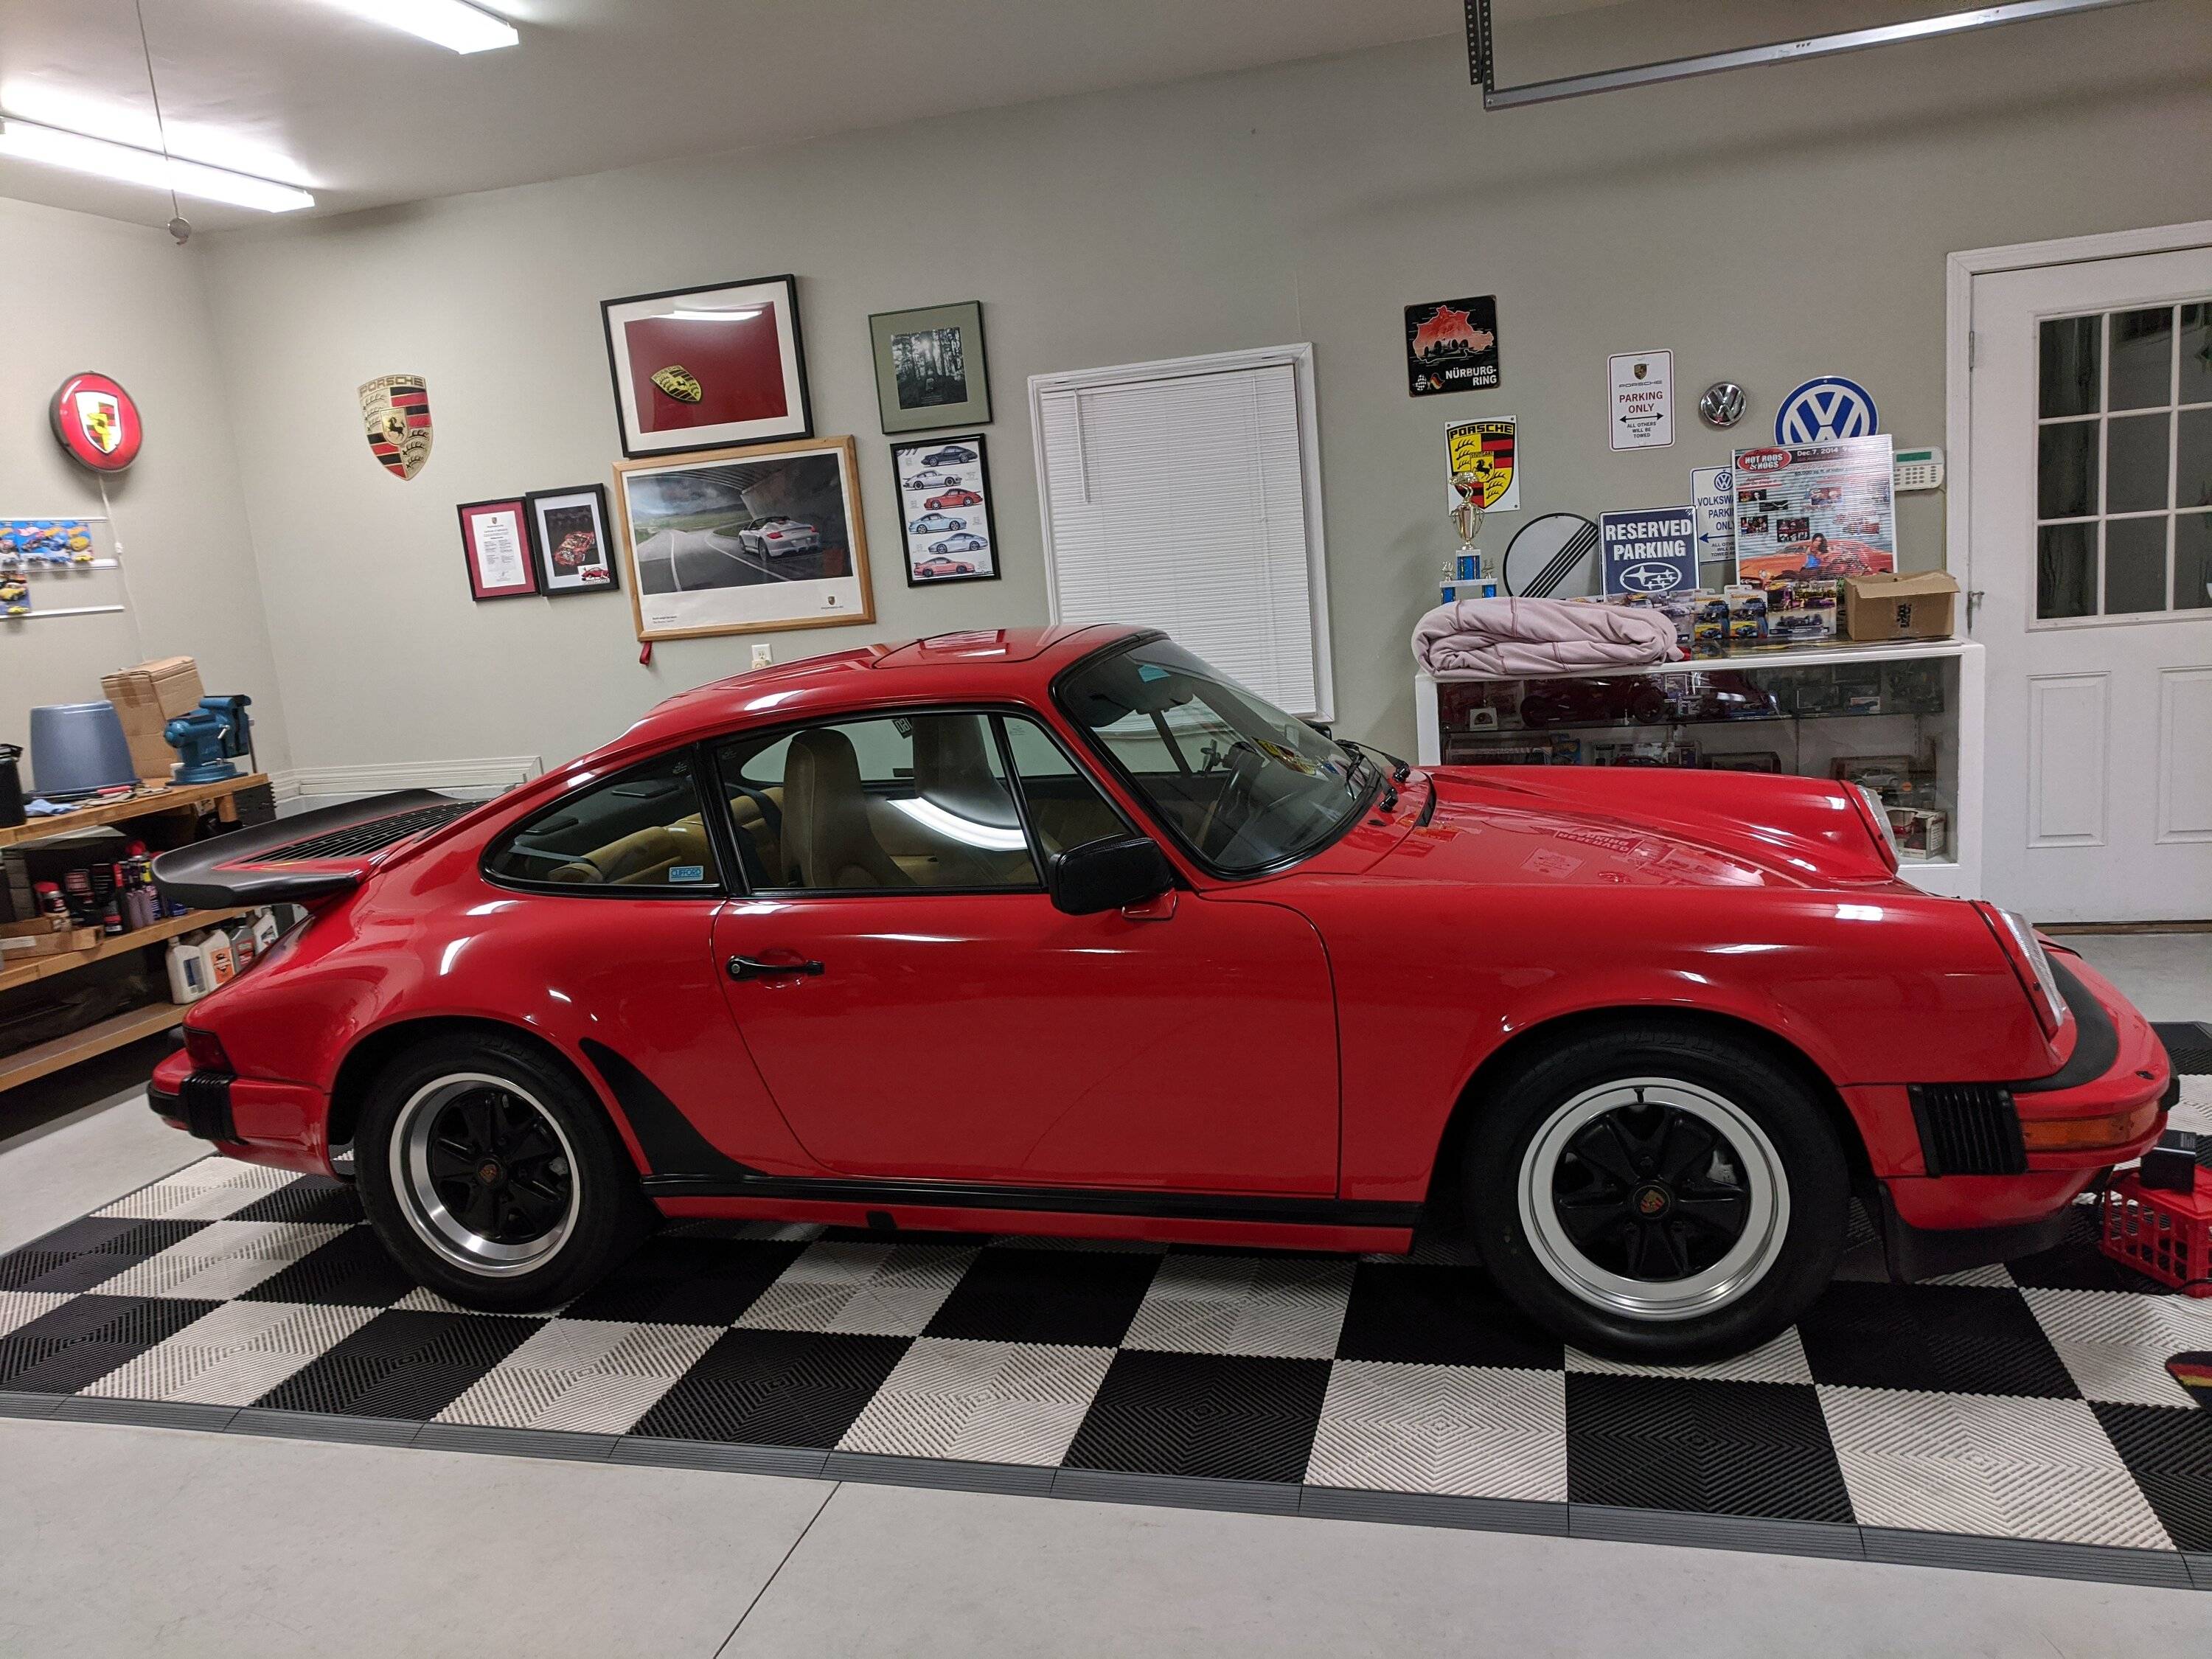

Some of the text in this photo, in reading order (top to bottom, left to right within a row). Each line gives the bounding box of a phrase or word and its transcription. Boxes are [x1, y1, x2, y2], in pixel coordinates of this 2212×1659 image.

[1445, 366, 1497, 380] NÜRBURG-
[359, 376, 424, 397] PORSCHE
[1472, 375, 1497, 386] RING
[1619, 391, 1663, 403] PARKING
[1628, 403, 1654, 414] ONLY
[1450, 424, 1514, 439] PORSCHE
[1745, 453, 1783, 464] HOT RODS
[1605, 518, 1692, 541] RESERVED
[1613, 540, 1686, 561] PARKING
